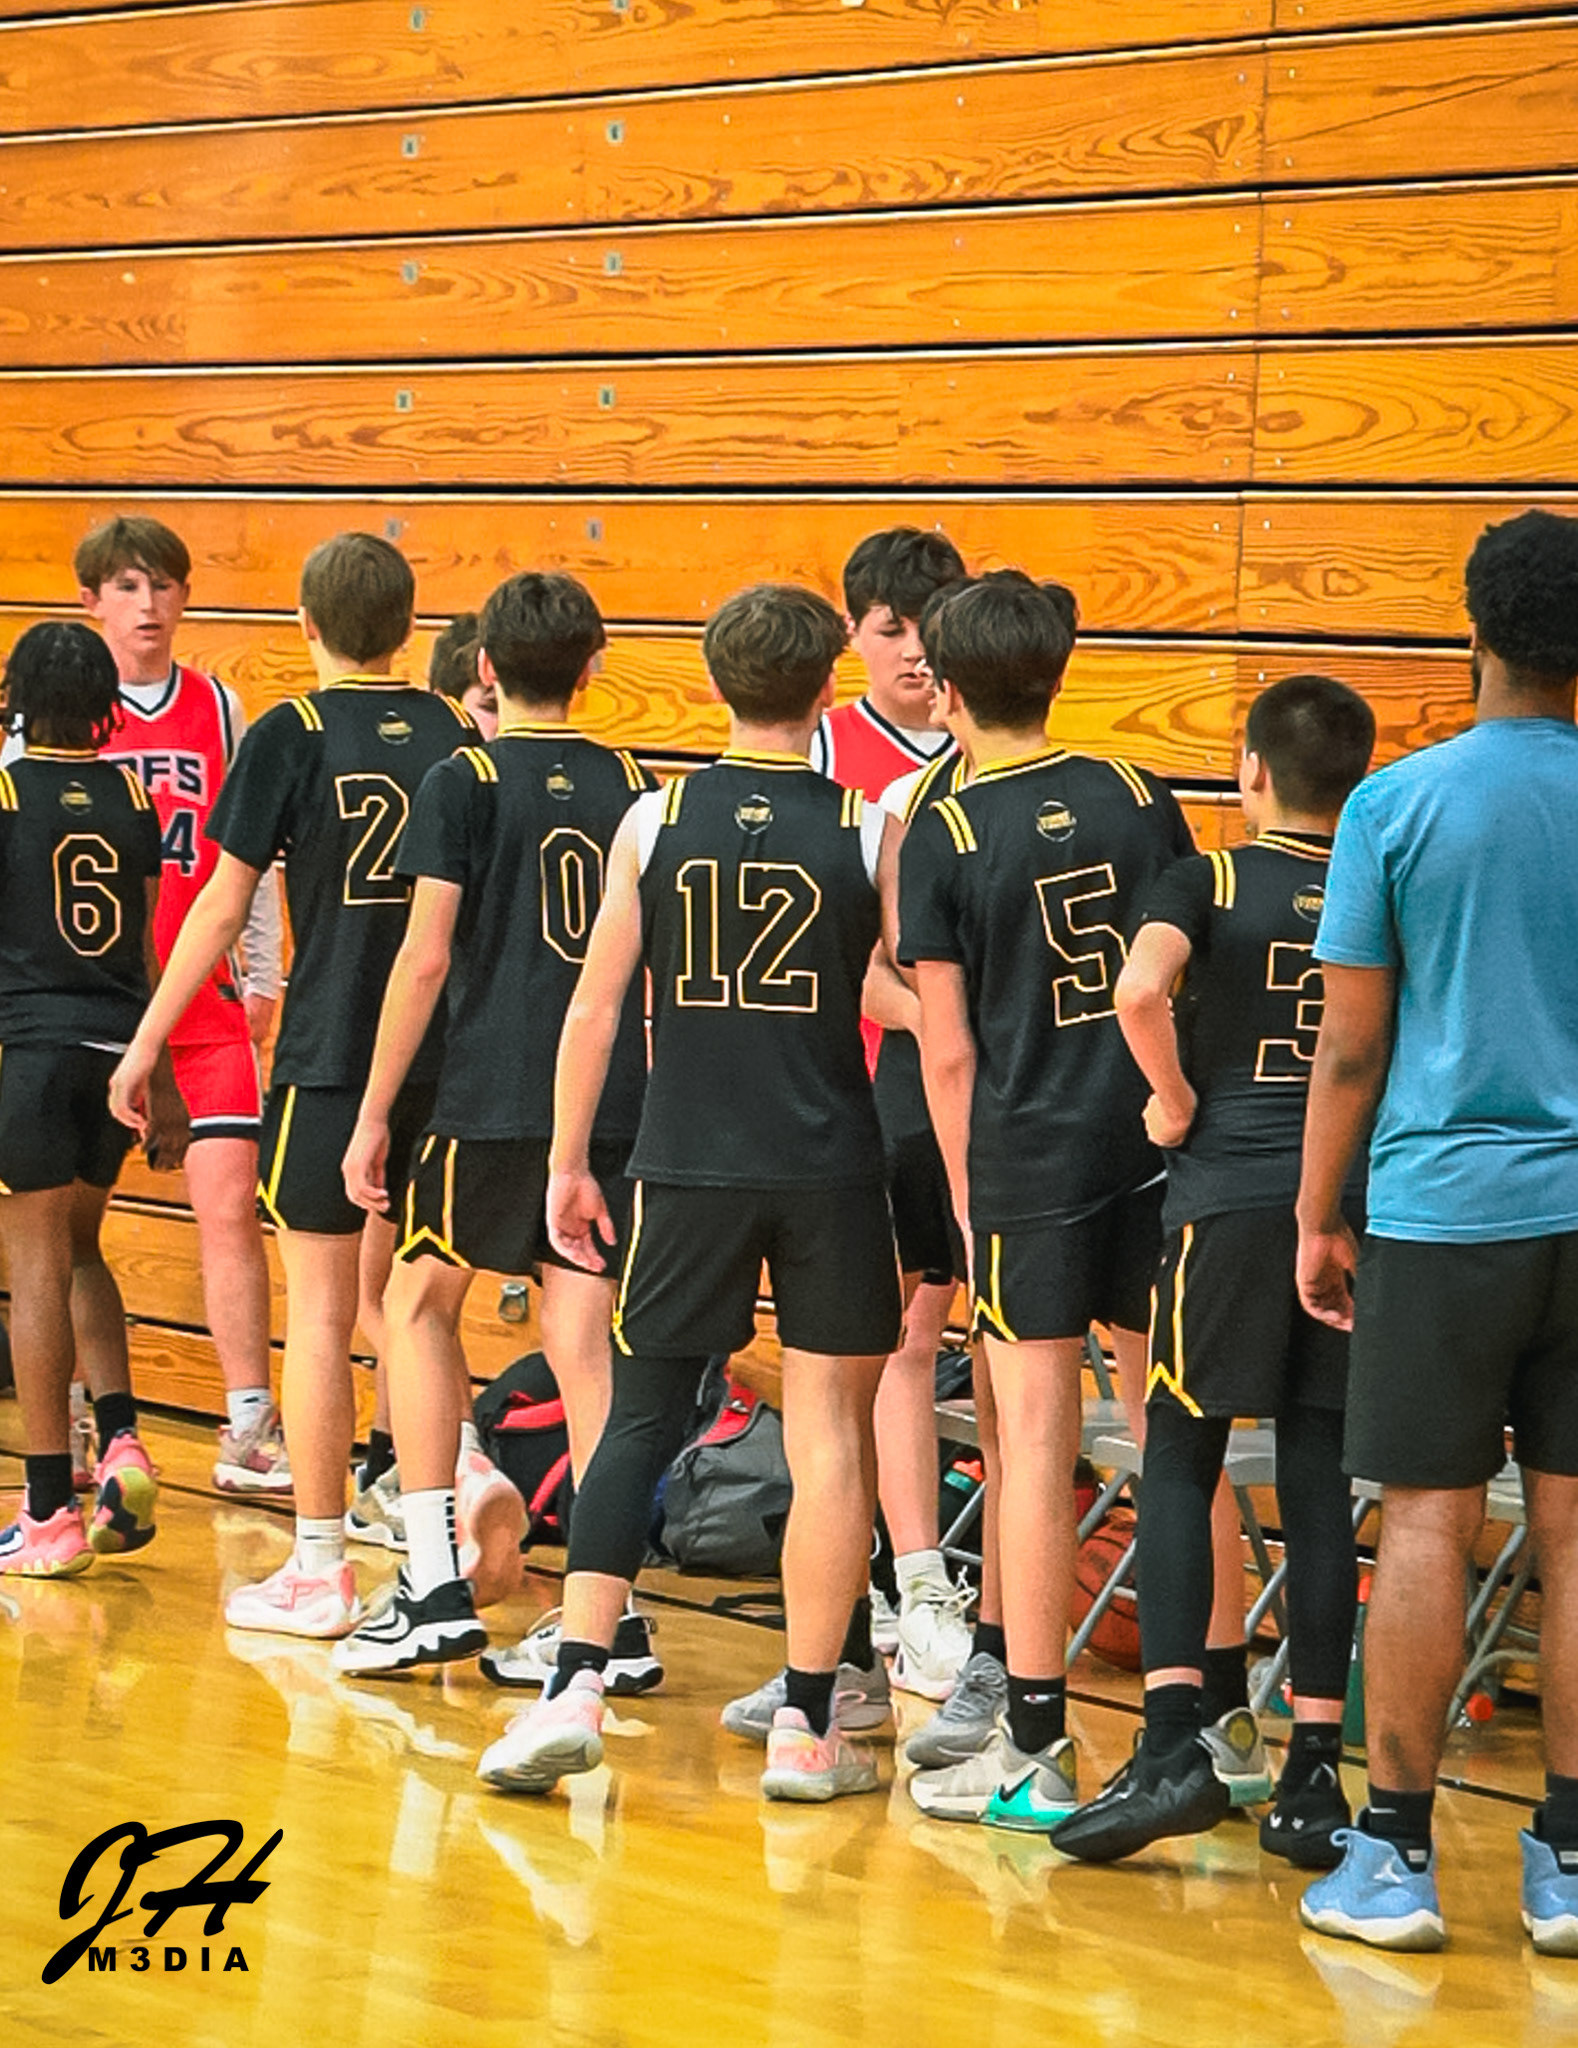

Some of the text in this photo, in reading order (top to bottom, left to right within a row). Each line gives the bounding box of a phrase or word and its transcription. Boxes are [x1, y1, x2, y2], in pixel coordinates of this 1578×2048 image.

[52, 833, 121, 957] 6
[334, 773, 412, 905] 2
[540, 827, 604, 963] 0
[675, 858, 822, 1013] 12
[1034, 863, 1131, 1027] 5
